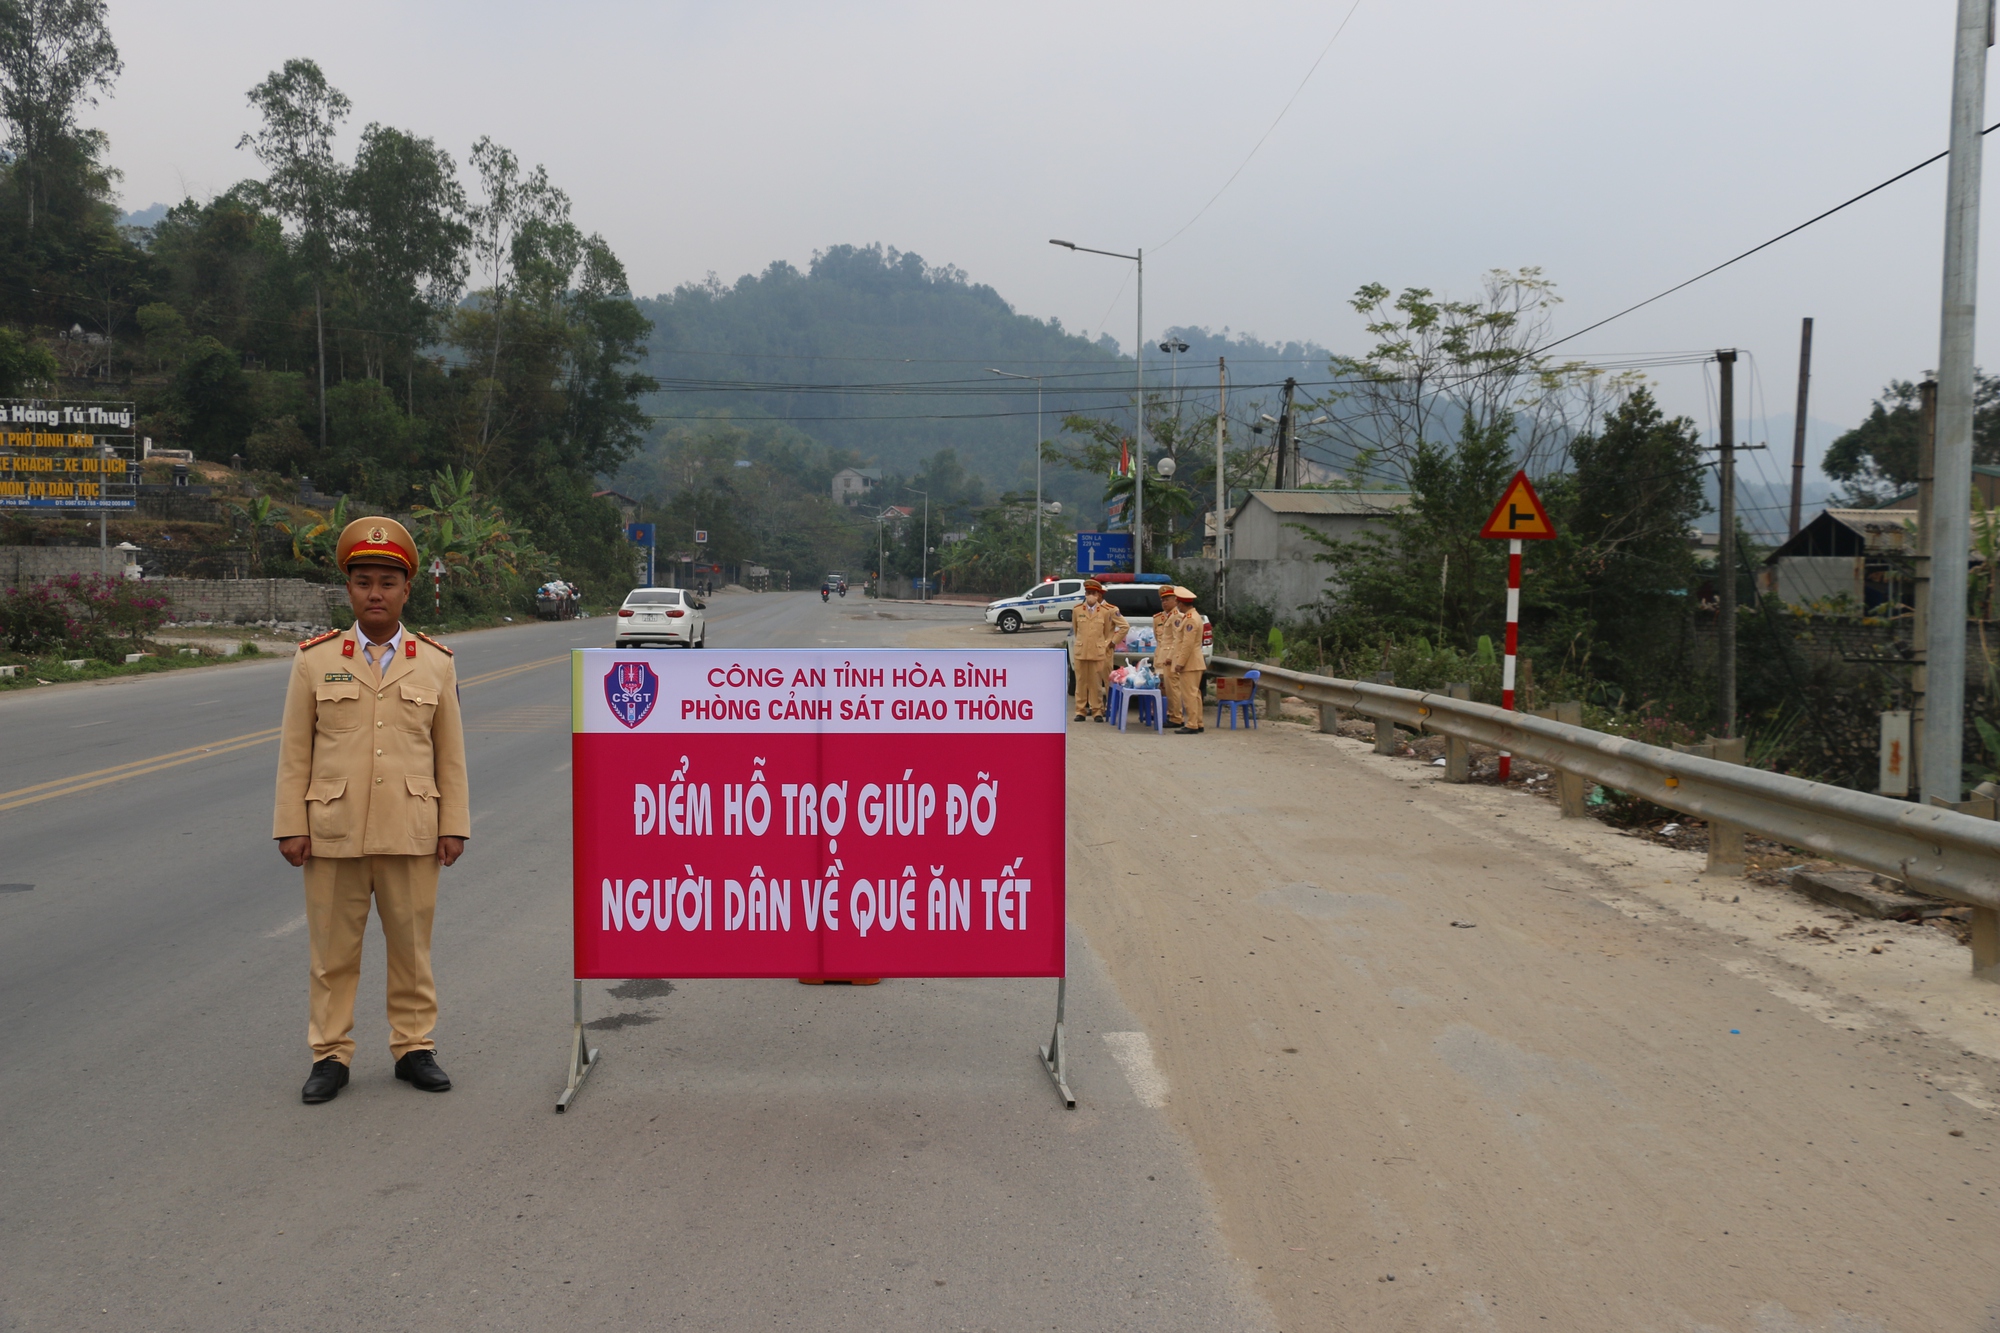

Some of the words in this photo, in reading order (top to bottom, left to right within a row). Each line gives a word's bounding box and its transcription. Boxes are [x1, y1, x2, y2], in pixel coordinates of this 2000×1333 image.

[12, 405, 59, 427] Hàng
[64, 406, 84, 424] Tú
[88, 407, 131, 428] Thuý
[8, 428, 33, 447] PHỞ
[35, 429, 64, 448] BÌNH
[67, 430, 94, 448] DÂN
[13, 454, 53, 472] KHÁCH
[63, 458, 79, 472] XE
[82, 458, 98, 472] DU
[101, 458, 127, 477] LỊCH
[29, 478, 46, 496] ĂN
[49, 478, 74, 496] DÂN
[77, 478, 99, 500] TỘC
[707, 663, 785, 688] CÔNG
[791, 668, 826, 688] AN
[833, 661, 884, 688] TỈNH
[892, 662, 946, 688] HÒA
[954, 662, 1007, 688] BÌNH
[681, 694, 761, 720] PHÒNG
[768, 691, 832, 720] CẢNH
[840, 694, 884, 720] SÁT
[891, 699, 948, 720] GIAO
[954, 694, 1033, 720] THÔNG
[633, 755, 713, 836] ĐIỂM
[724, 756, 771, 836] HỖ
[781, 780, 848, 854] TRỢ
[857, 768, 936, 836] GIÚP
[946, 770, 998, 836] ĐỠ
[602, 864, 713, 932] NGƯỜI
[724, 865, 791, 932] DÂN
[801, 858, 844, 932] VỀ
[850, 865, 917, 937] QUÊ
[927, 864, 971, 932] ĂN
[981, 857, 1031, 931] TẾT
